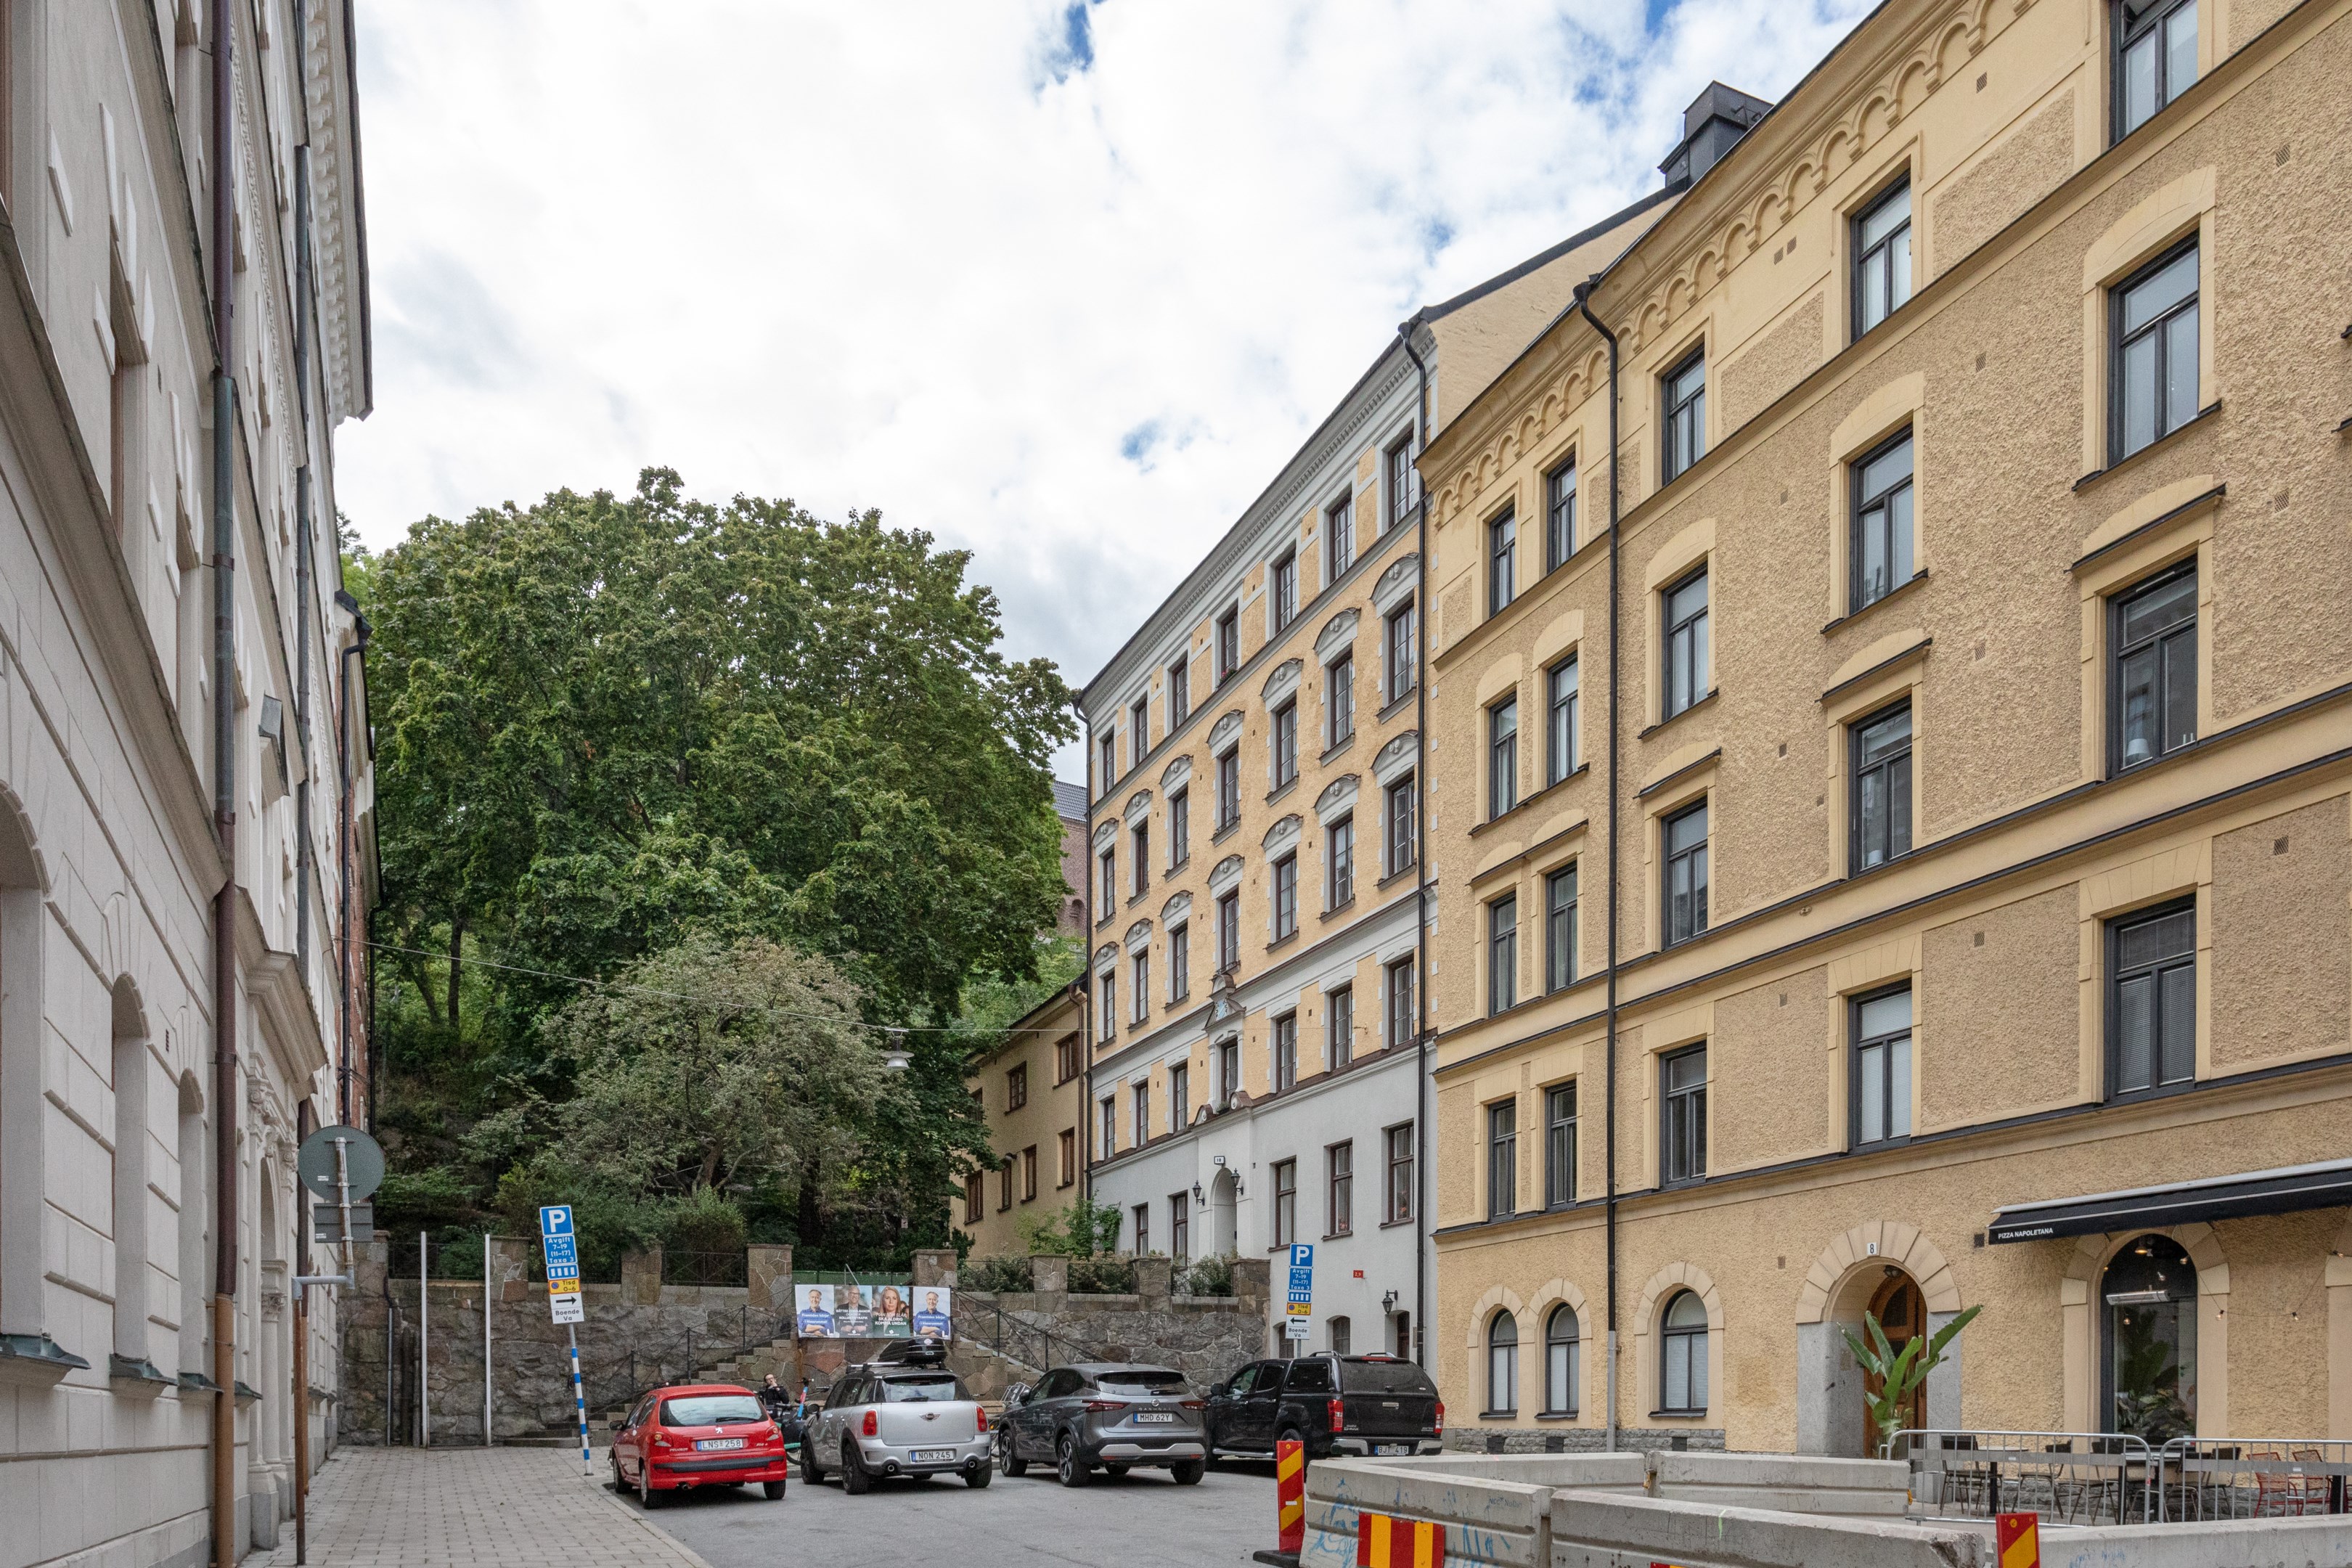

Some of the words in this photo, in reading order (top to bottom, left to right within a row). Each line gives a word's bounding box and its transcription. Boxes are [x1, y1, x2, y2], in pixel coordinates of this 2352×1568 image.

[549, 1209, 566, 1233] P
[2014, 1228, 2054, 1237] NAPOLETANA
[1296, 1246, 1310, 1265] P
[1870, 1244, 1874, 1254] 8
